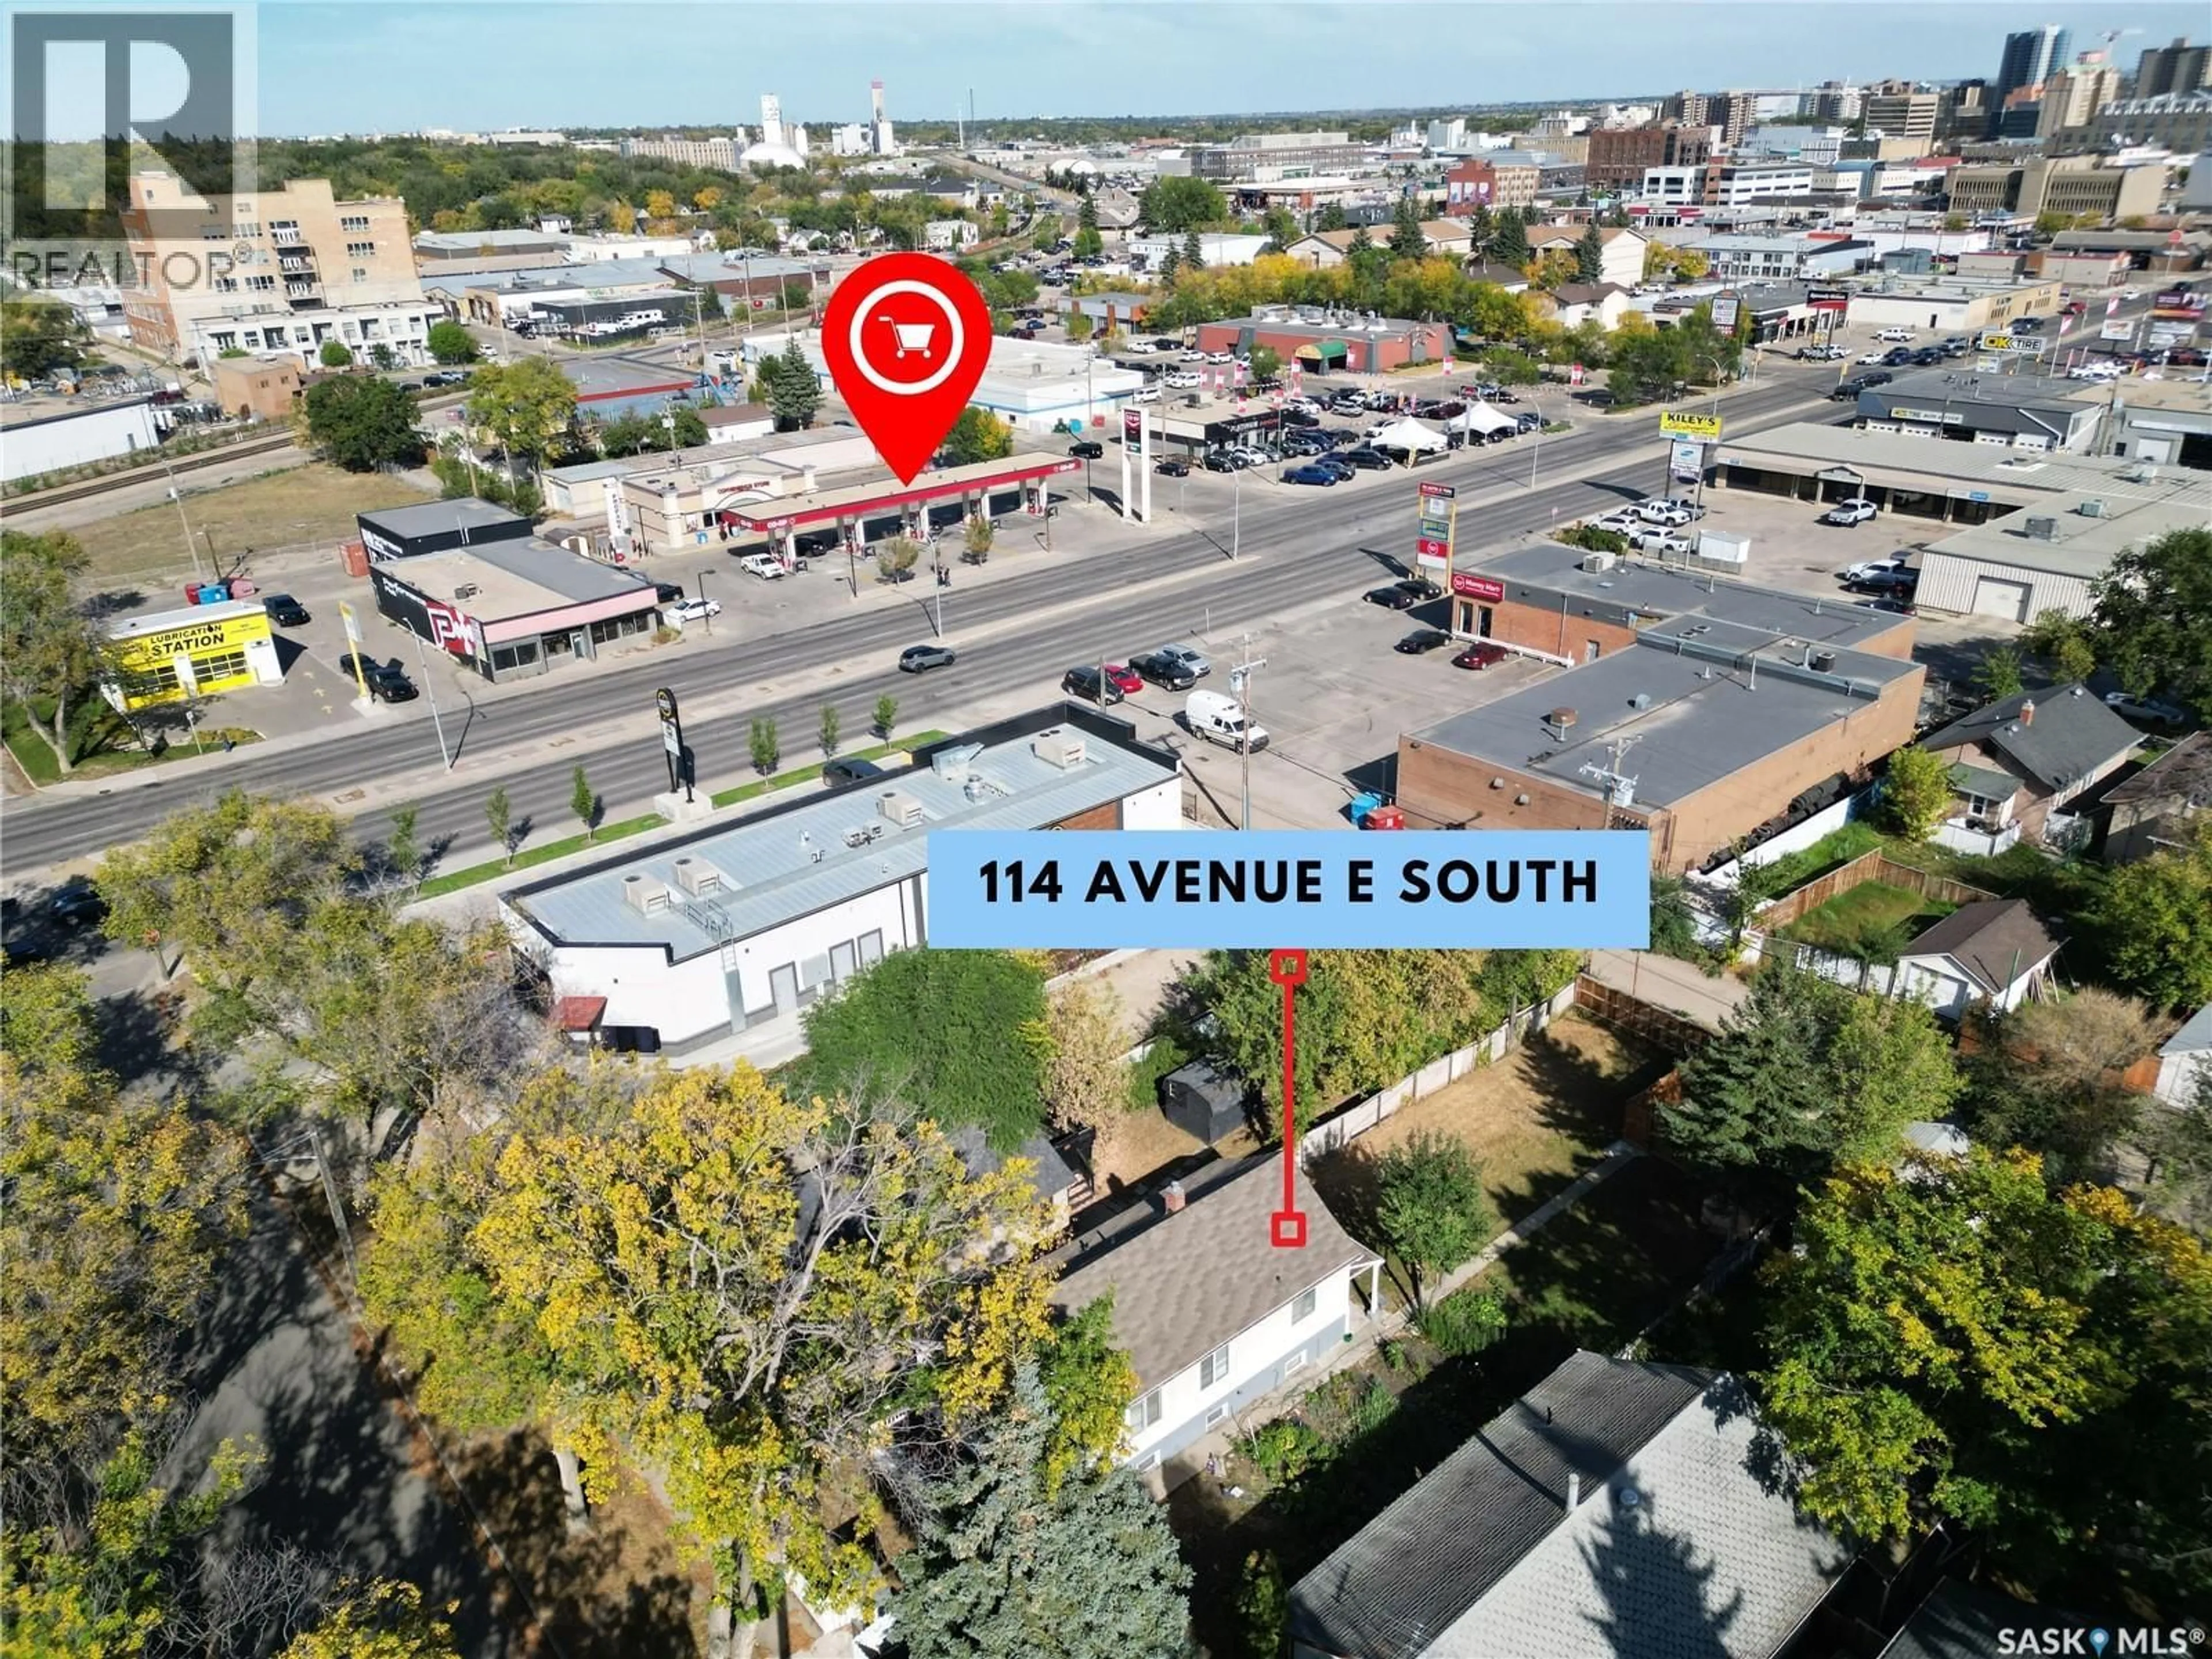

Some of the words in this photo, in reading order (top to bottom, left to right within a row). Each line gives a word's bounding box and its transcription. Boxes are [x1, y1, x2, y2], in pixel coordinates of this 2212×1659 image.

[1985, 336, 2009, 349] OK
[2017, 340, 2040, 350] TIRE
[1668, 414, 1715, 426] KILEY'S
[152, 632, 225, 656] STATION
